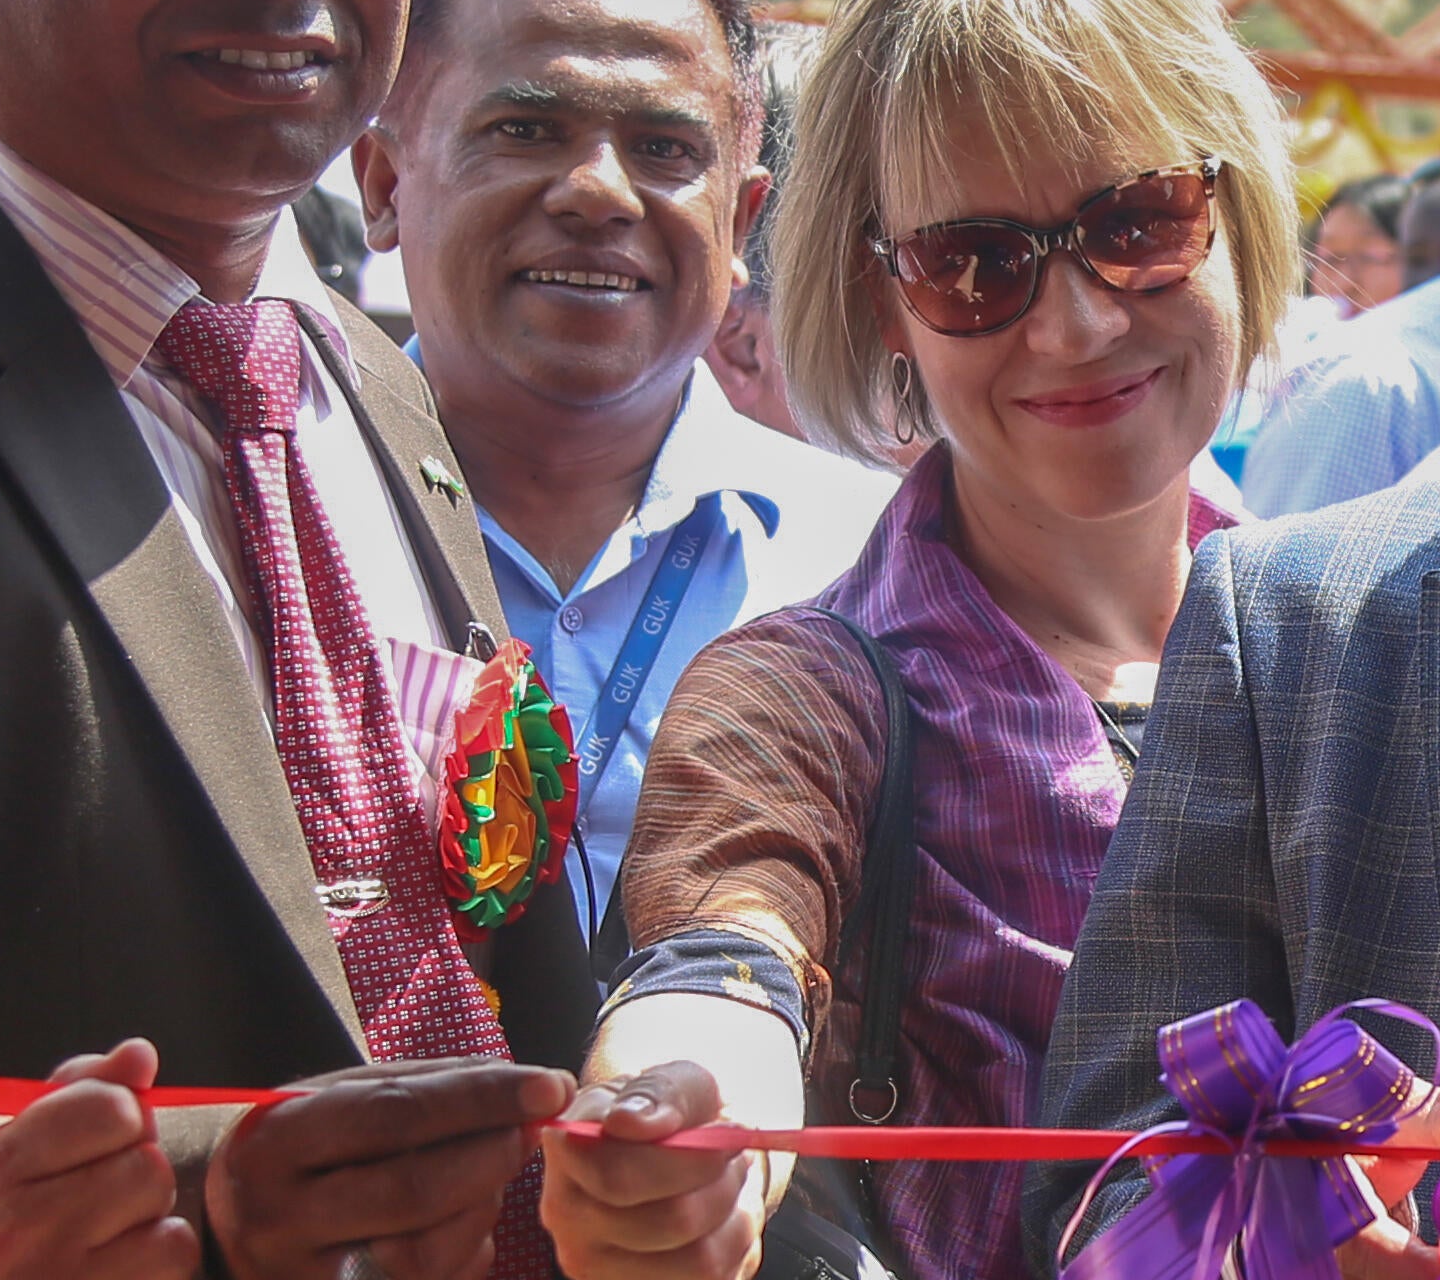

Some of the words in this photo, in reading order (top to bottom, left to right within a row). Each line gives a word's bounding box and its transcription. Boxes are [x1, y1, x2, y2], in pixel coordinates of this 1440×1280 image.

[578, 732, 611, 776] GUK
[611, 662, 643, 705] GUK
[642, 594, 672, 636] GUK
[670, 534, 702, 570] GUK
